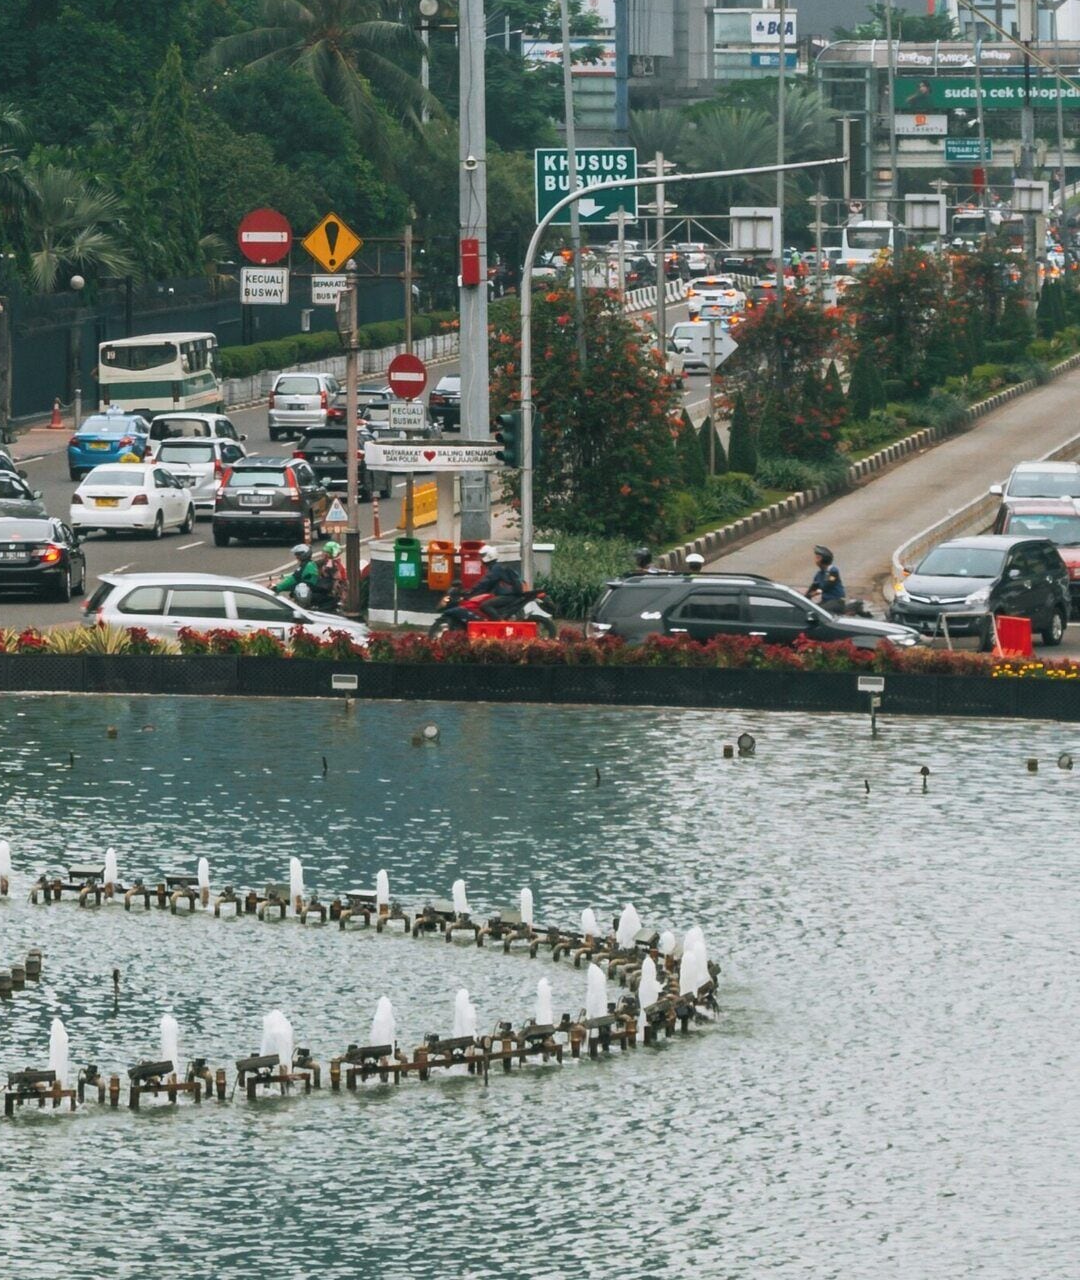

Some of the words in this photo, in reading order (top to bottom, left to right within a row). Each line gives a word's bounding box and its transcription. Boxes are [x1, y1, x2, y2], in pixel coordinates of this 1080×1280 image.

[990, 86, 1014, 98] cek
[544, 155, 627, 171] KHUSUS
[245, 275, 284, 284] KECUALI
[244, 288, 284, 297] BUSWAY
[392, 407, 423, 415] KECUALI
[393, 417, 421, 425] BUSWAY
